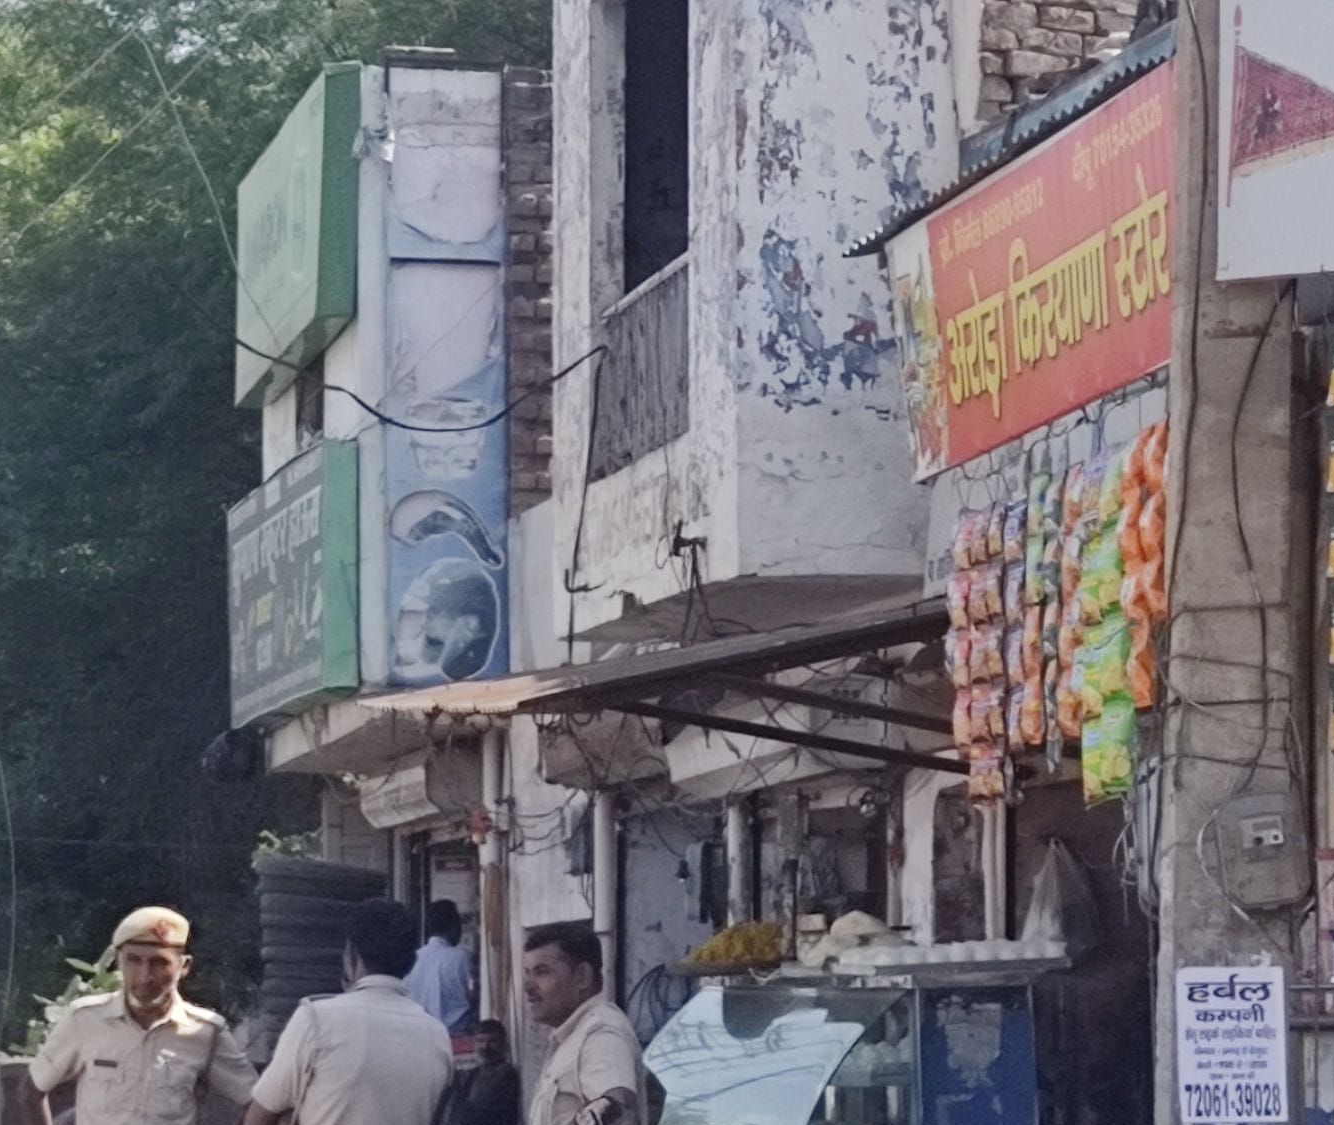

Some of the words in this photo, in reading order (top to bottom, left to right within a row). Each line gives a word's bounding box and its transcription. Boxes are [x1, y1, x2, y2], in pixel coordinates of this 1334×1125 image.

[947, 268, 1009, 421] अरोड़ा
[1008, 229, 1110, 374] किरयाणा
[1111, 162, 1171, 319] स्टोर
[1194, 1004, 1264, 1022] कम्पनी
